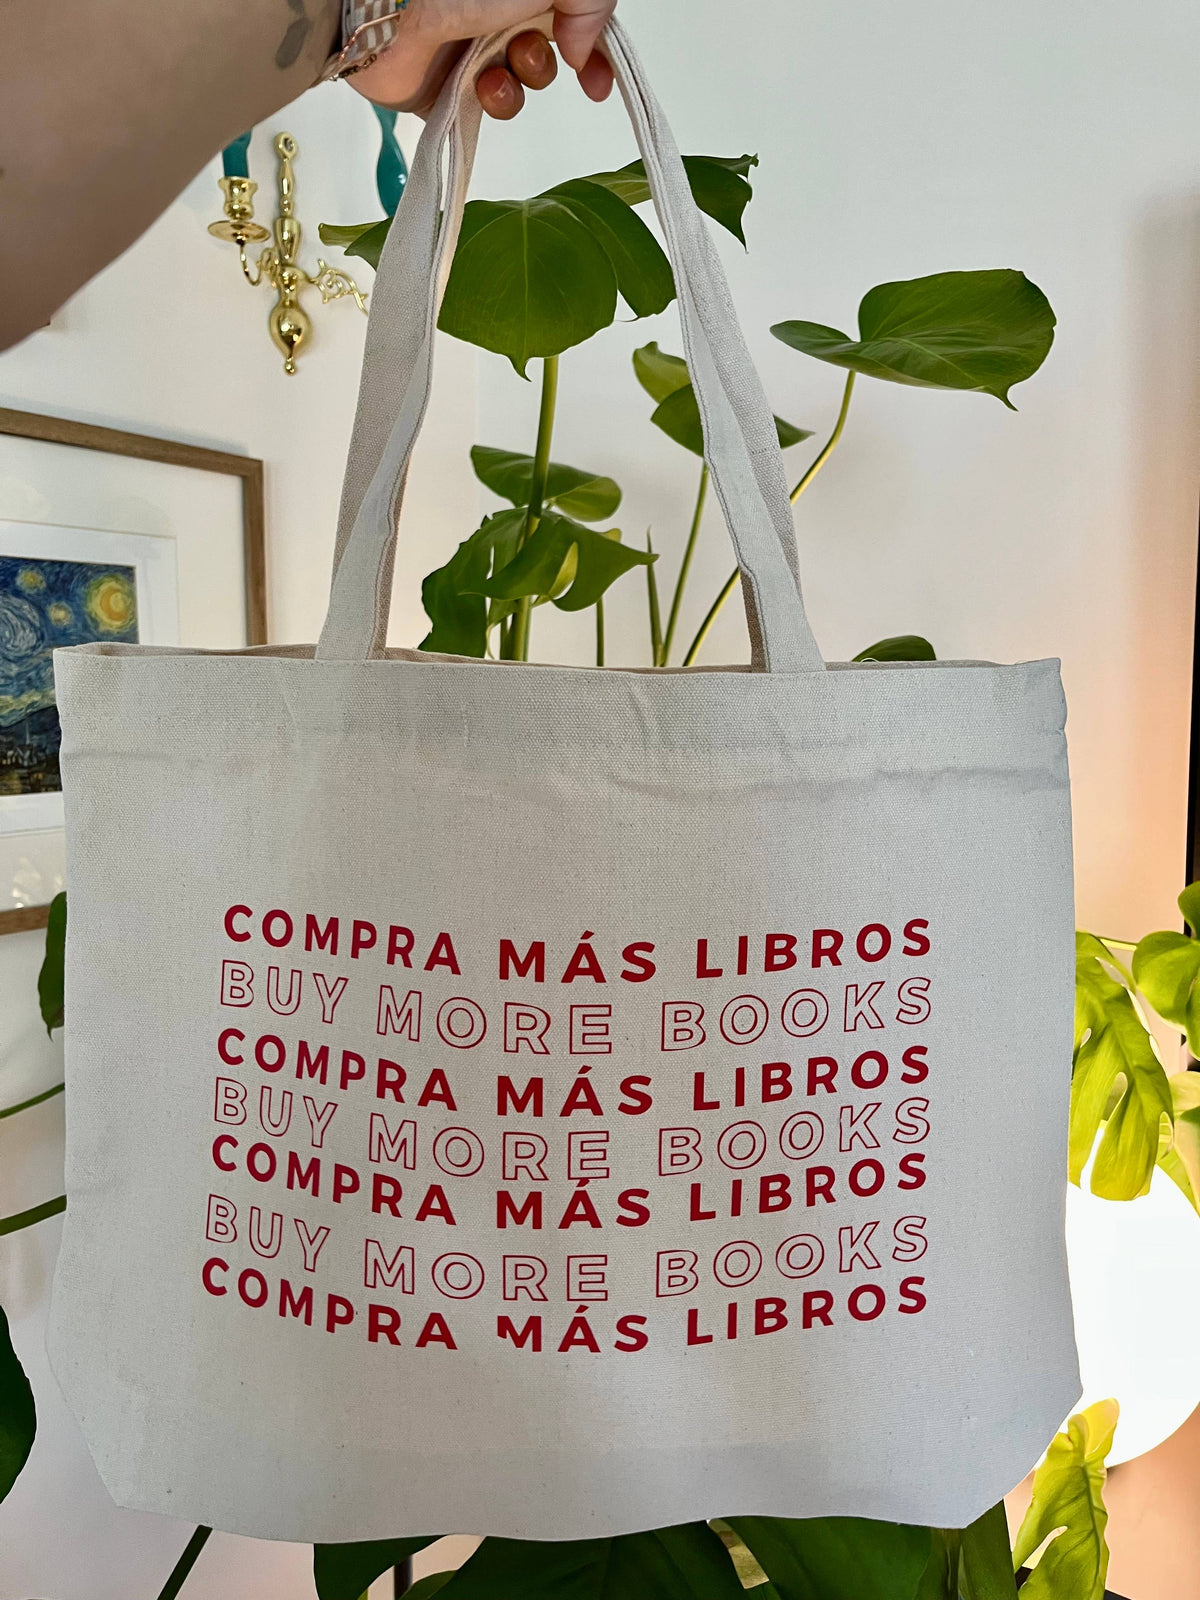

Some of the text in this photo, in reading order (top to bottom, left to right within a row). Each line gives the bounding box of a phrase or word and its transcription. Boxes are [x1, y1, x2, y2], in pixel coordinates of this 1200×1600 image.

[224, 905, 932, 985] COMPRA MÁS LIBROS
[221, 960, 932, 1056] BUY MORE BOOKS
[218, 1028, 931, 1118] COMPRA MÁS LIBROS
[214, 1077, 931, 1181] BUY MORE BOOKS
[212, 1134, 928, 1231] COMPRA MÁS LIBROS
[205, 1194, 929, 1303] BUY MORE BOOKS
[202, 1258, 928, 1354] COMPRA MÁS LIBROS
